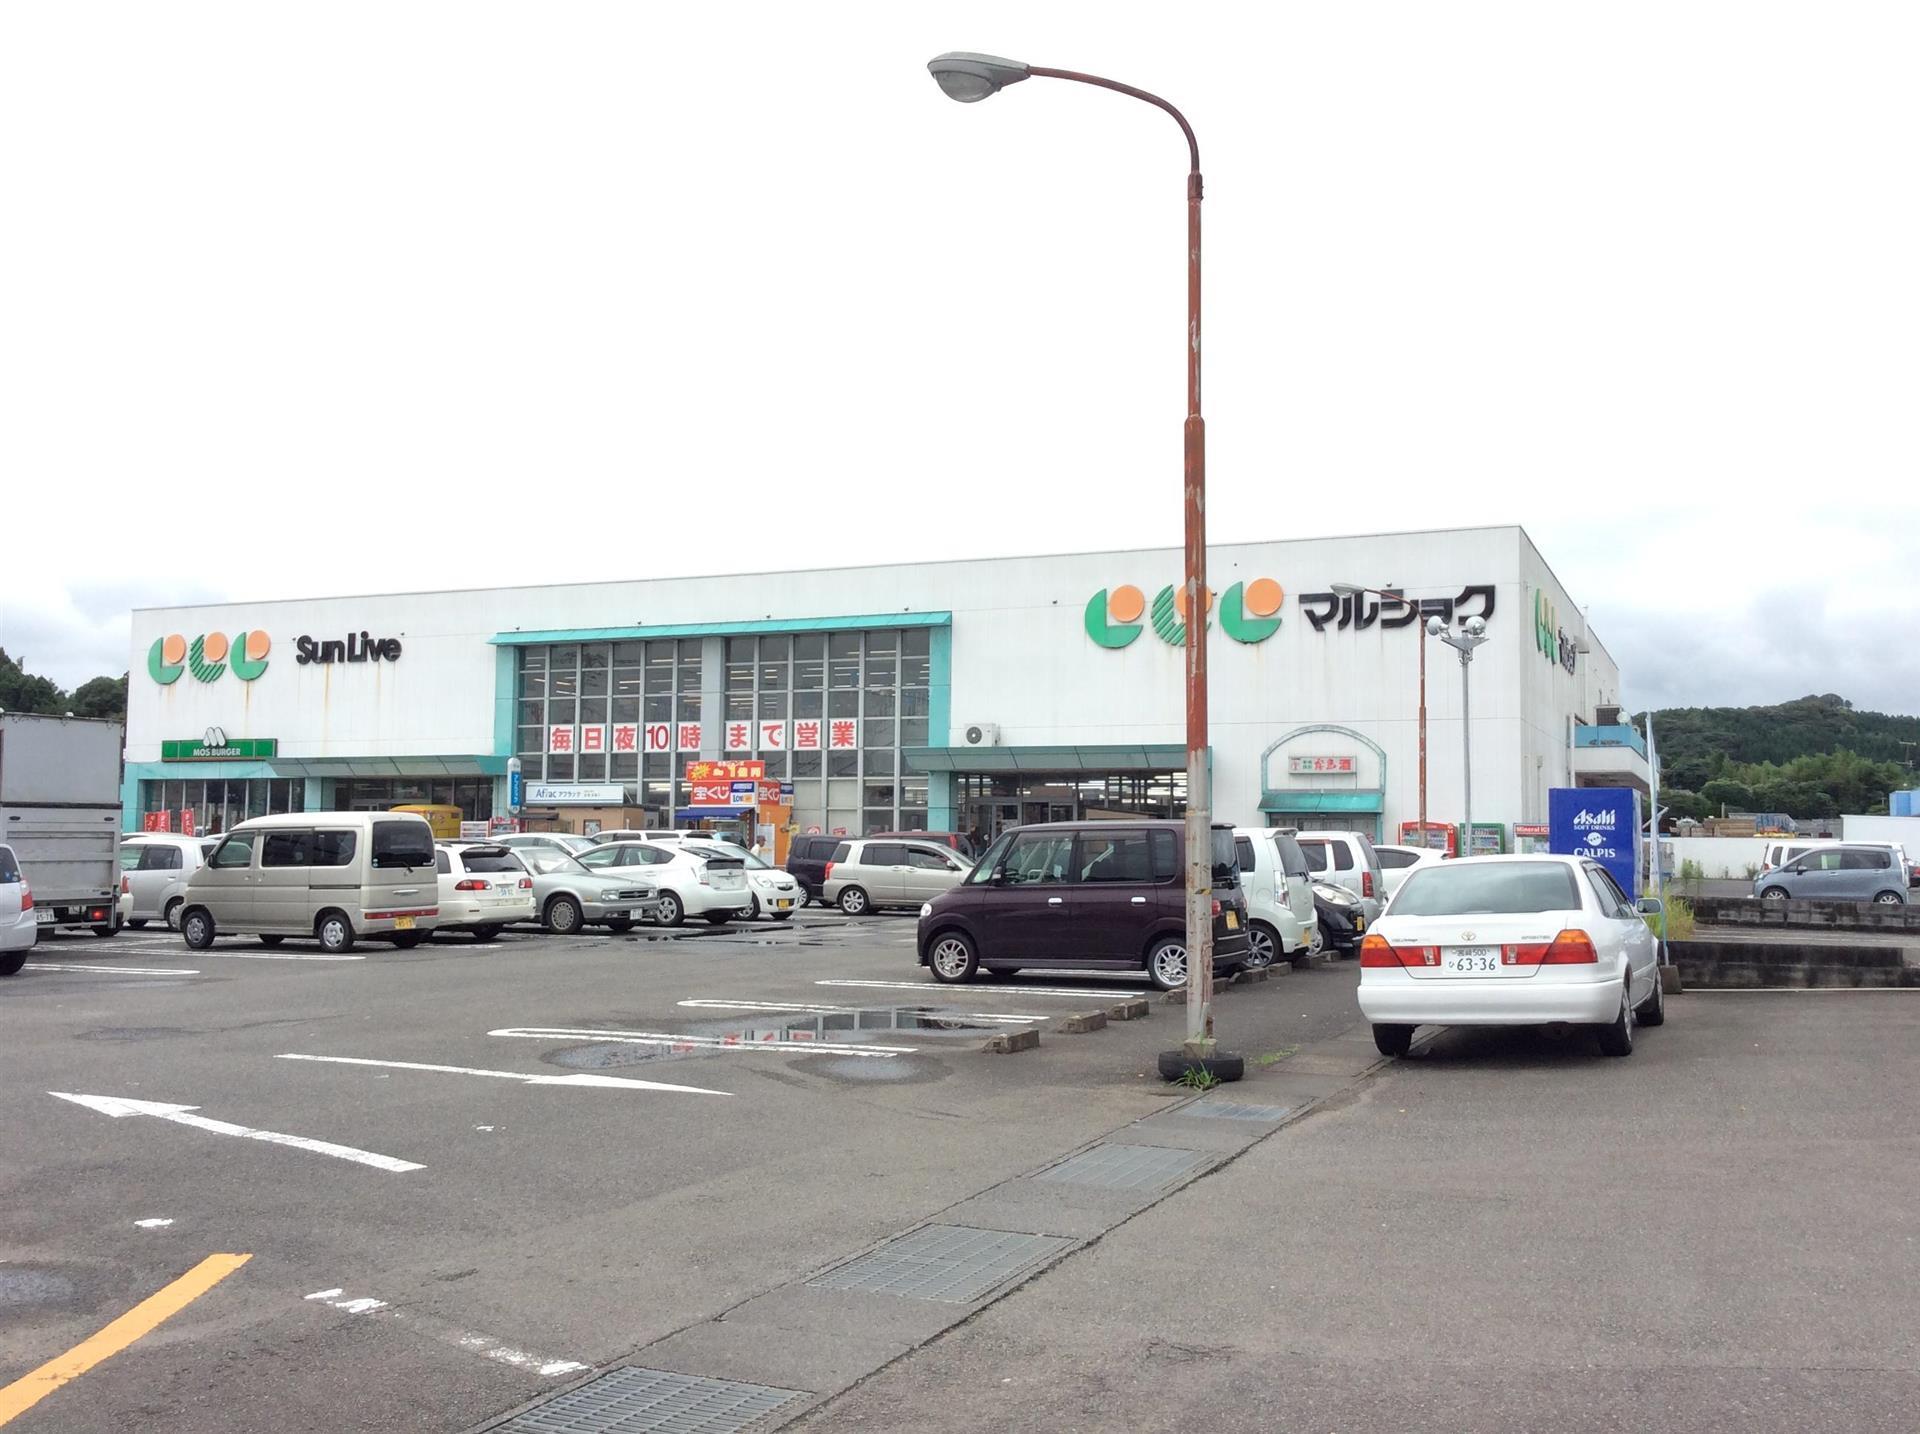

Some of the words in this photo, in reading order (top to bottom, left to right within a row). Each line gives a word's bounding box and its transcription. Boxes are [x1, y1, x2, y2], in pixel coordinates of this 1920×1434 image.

[193, 748, 210, 756] MOS
[211, 748, 241, 756] BURGER
[693, 785, 730, 801] 宝くじ
[1573, 809, 1616, 825] Asahi
[1574, 848, 1616, 858] CALPIS
[1457, 957, 1496, 971] 63-36
